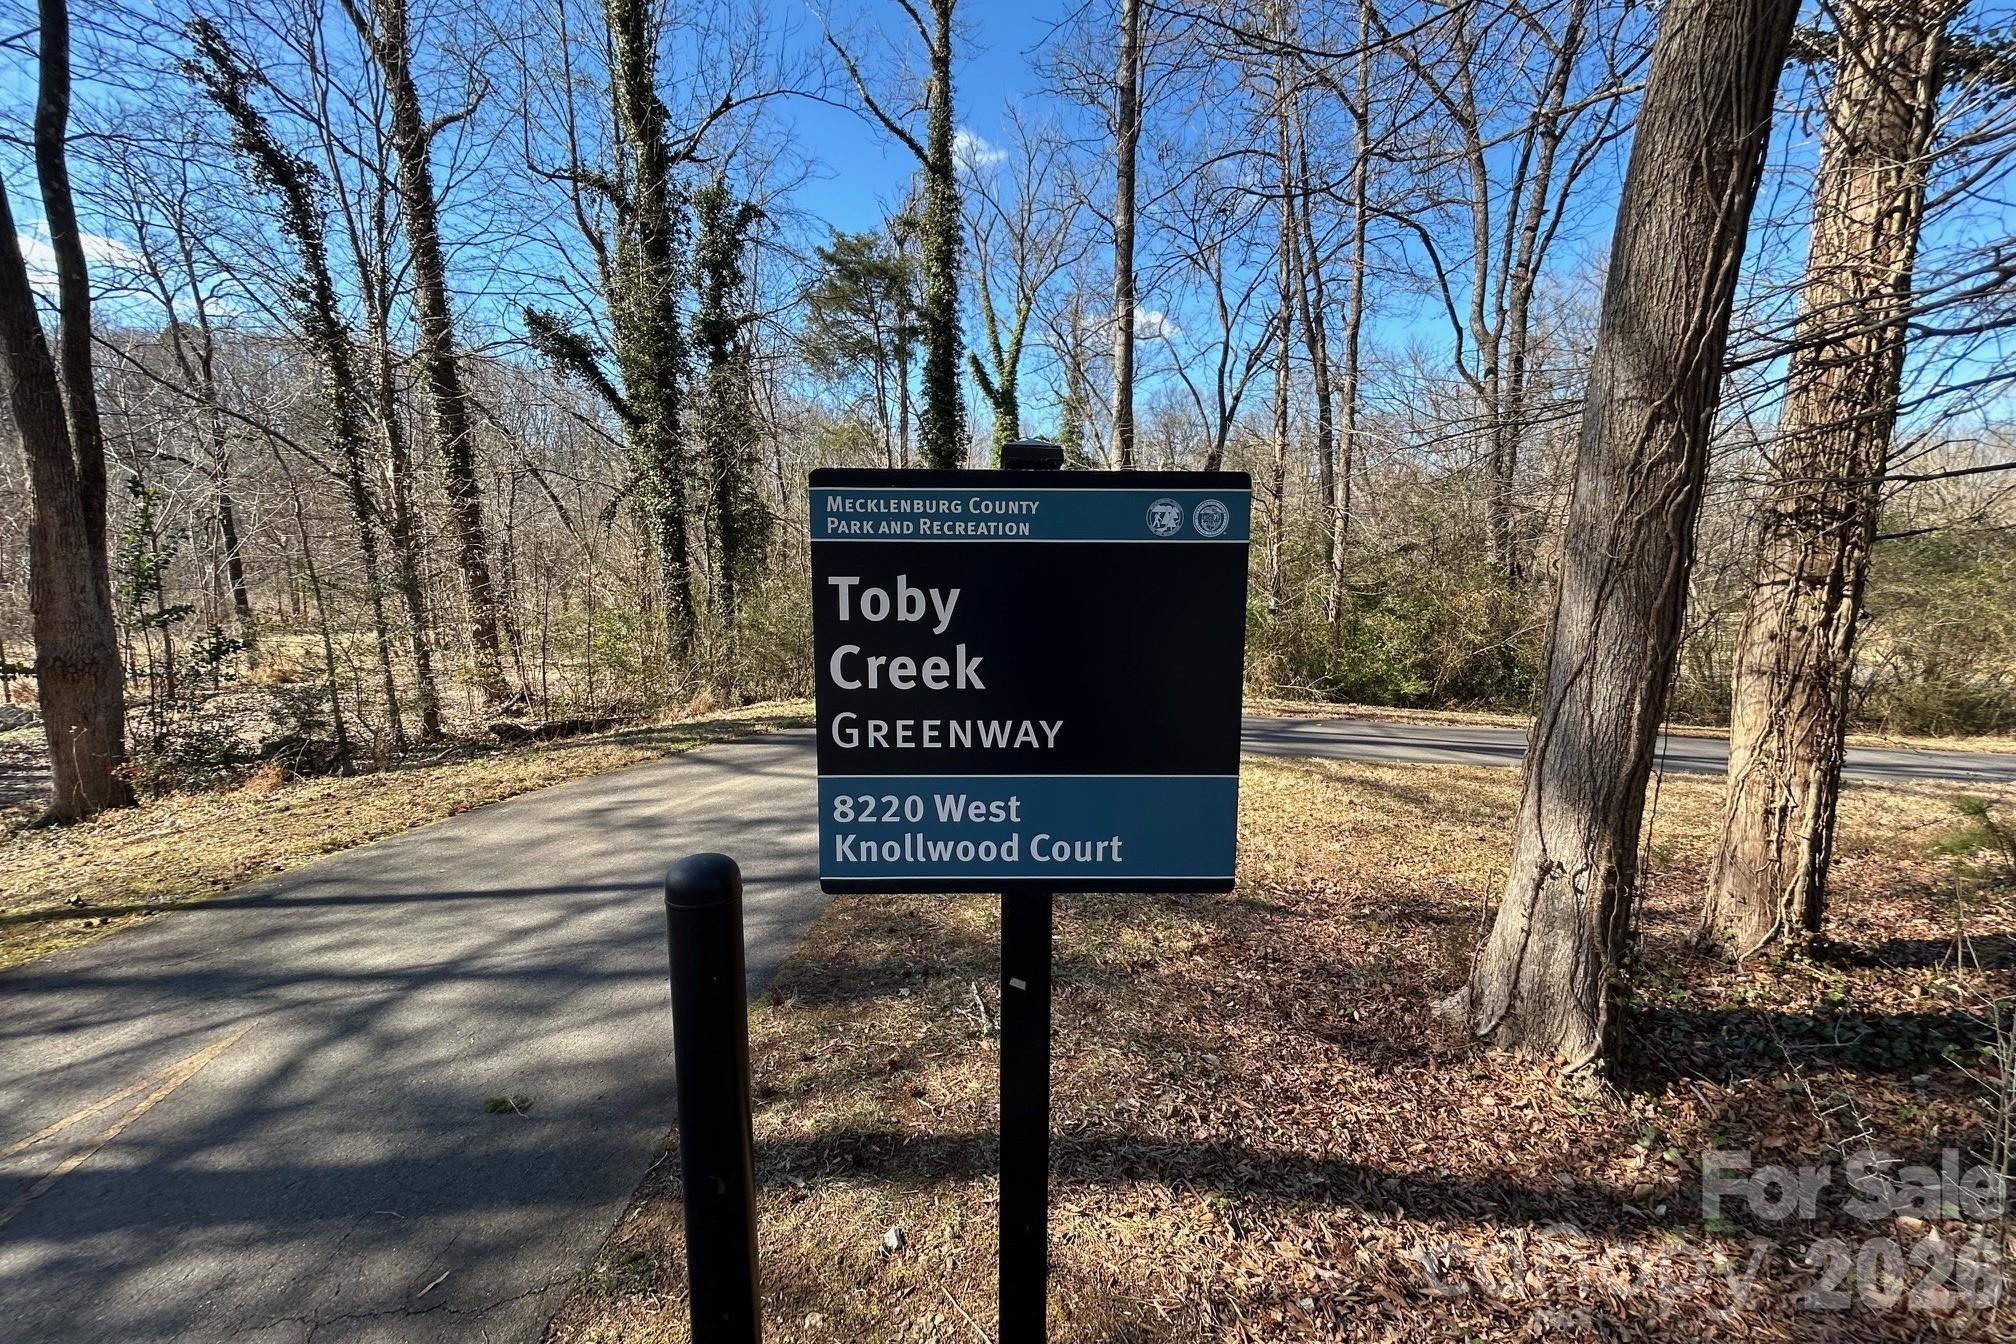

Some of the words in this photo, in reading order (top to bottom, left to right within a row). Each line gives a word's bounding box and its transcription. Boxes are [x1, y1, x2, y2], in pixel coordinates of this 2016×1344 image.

[826, 495, 963, 515] MECKLENBURG
[968, 497, 1040, 516] COUNTY
[826, 517, 875, 535] PARK
[878, 521, 915, 535] AND
[919, 518, 1031, 537] RECREATION
[828, 574, 961, 636] Toby
[829, 643, 987, 691] Creek
[831, 711, 1065, 749] GREENWAY
[832, 794, 925, 824] 8220
[933, 794, 1022, 823] West
[834, 832, 1020, 863] Knollwood
[1029, 833, 1124, 863] Court
